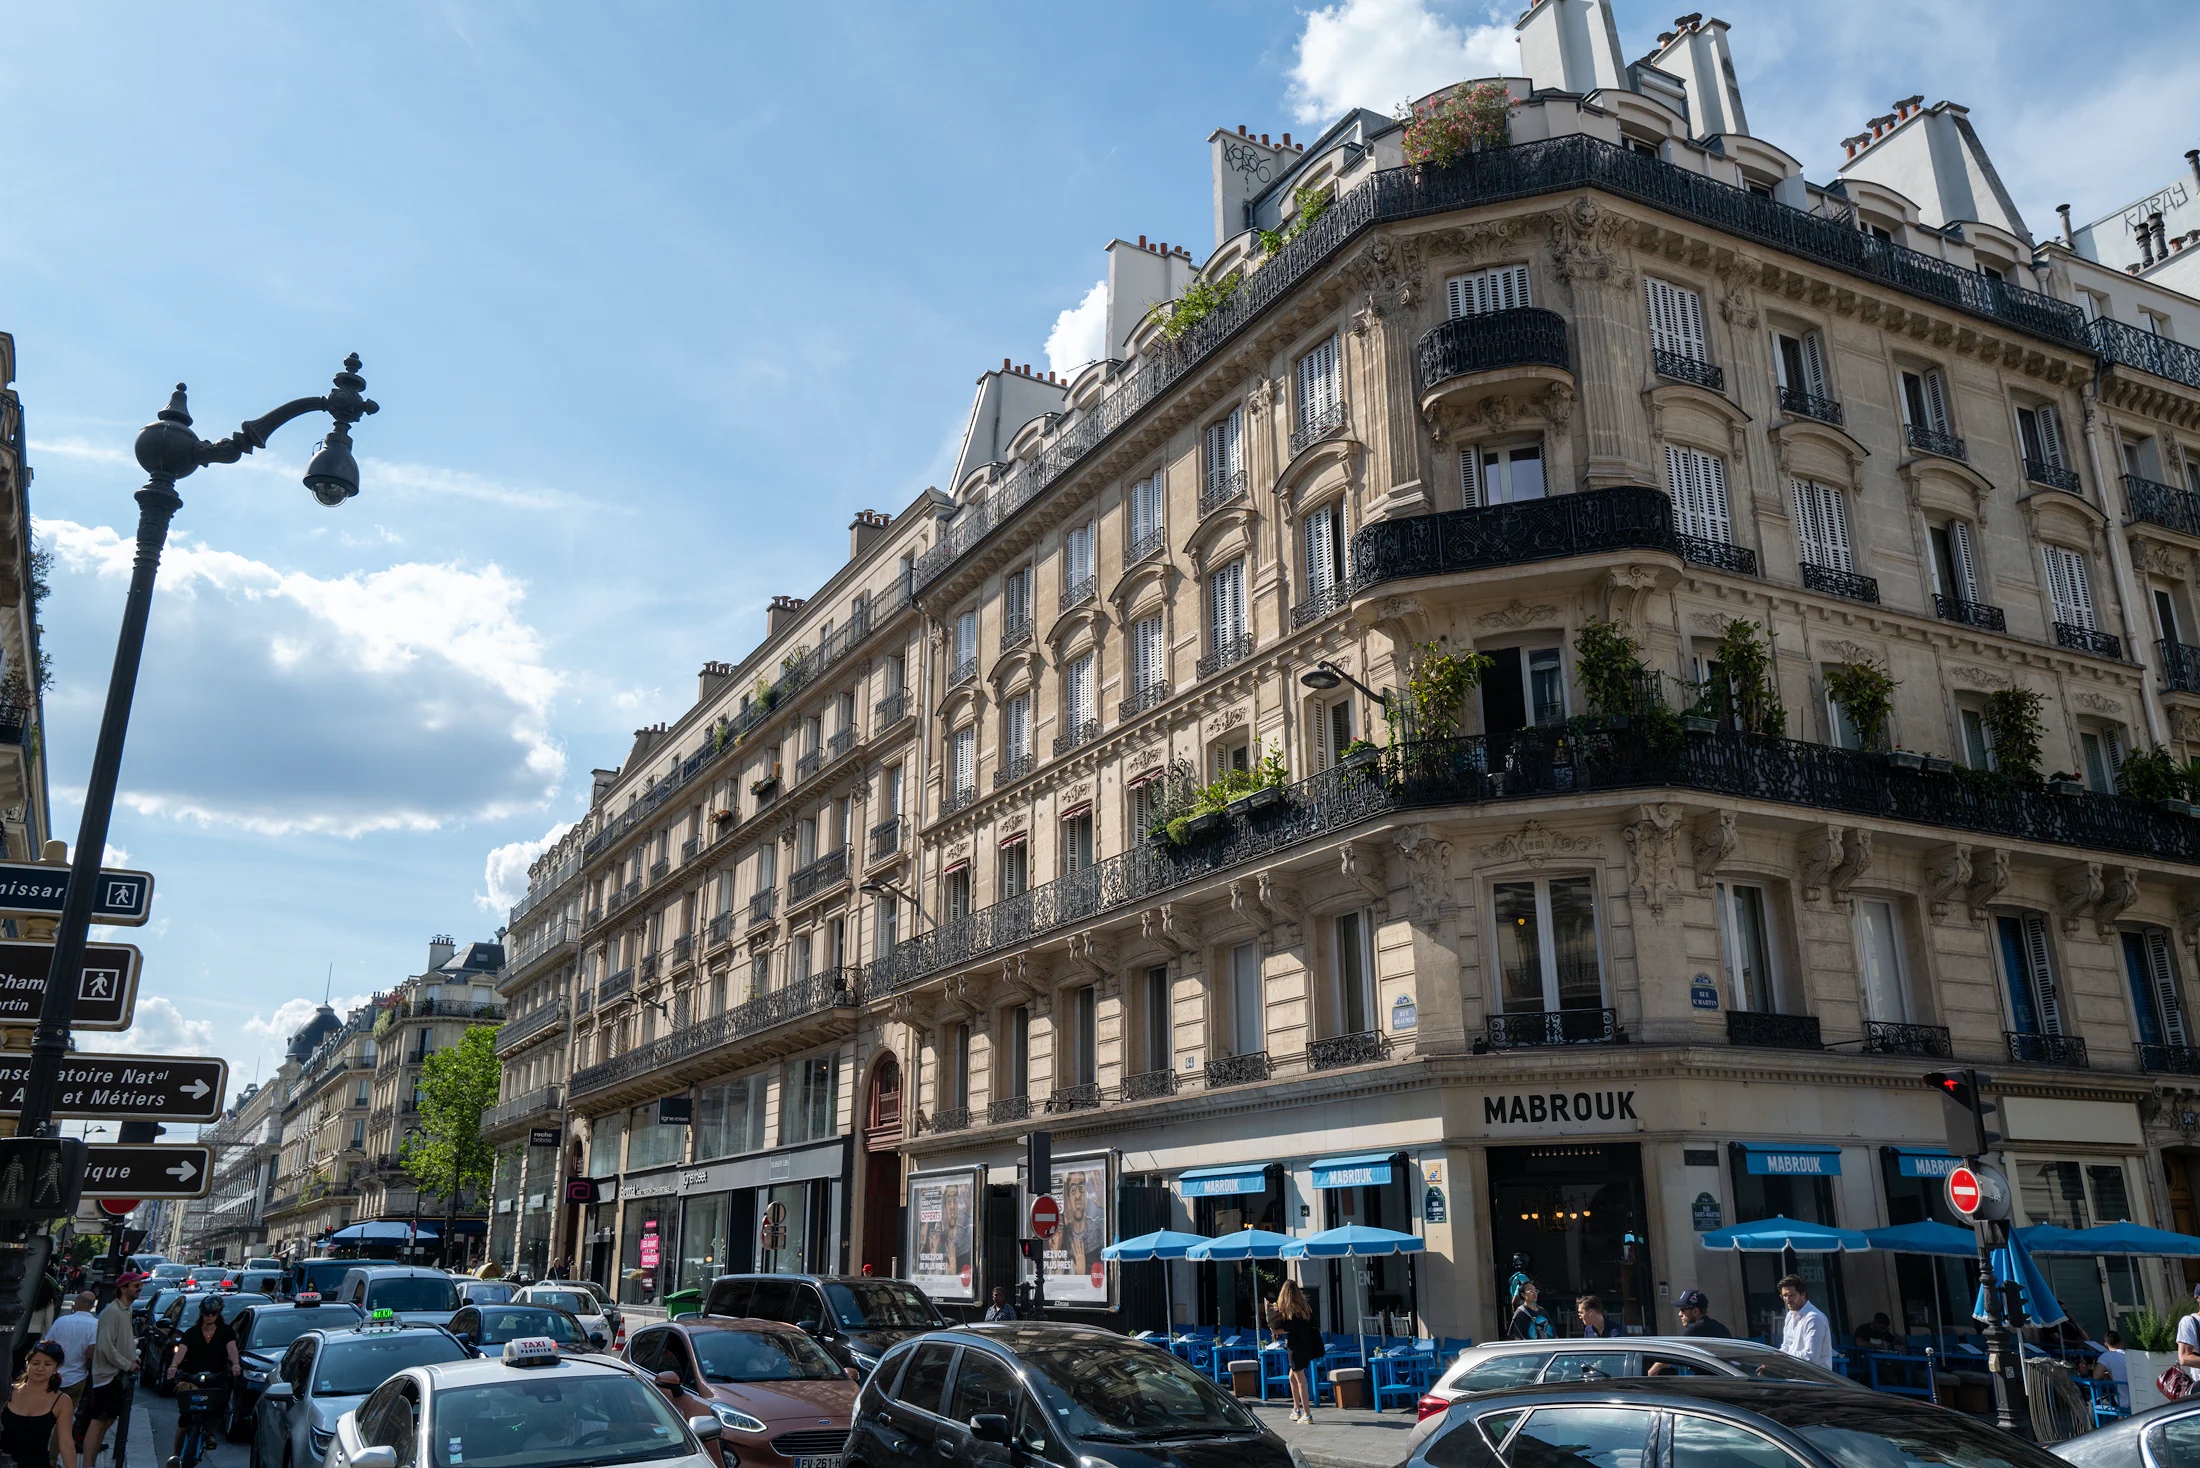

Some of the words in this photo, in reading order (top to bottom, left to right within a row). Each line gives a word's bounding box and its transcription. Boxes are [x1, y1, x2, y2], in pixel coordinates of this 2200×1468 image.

[0, 881, 68, 898] issar
[0, 998, 29, 1011] rtin
[62, 1090, 83, 1104] et
[90, 1089, 166, 1106] Métiers
[1484, 1091, 1638, 1124] MABROUK
[84, 1162, 131, 1182] ique
[1767, 1155, 1822, 1173] MABROUK
[1329, 1168, 1373, 1185] MABROUK
[1204, 1178, 1239, 1193] MABROUK
[921, 1211, 941, 1221] OFFERTS
[1053, 1250, 1068, 1259] VOIR
[375, 1309, 393, 1318] TAXI
